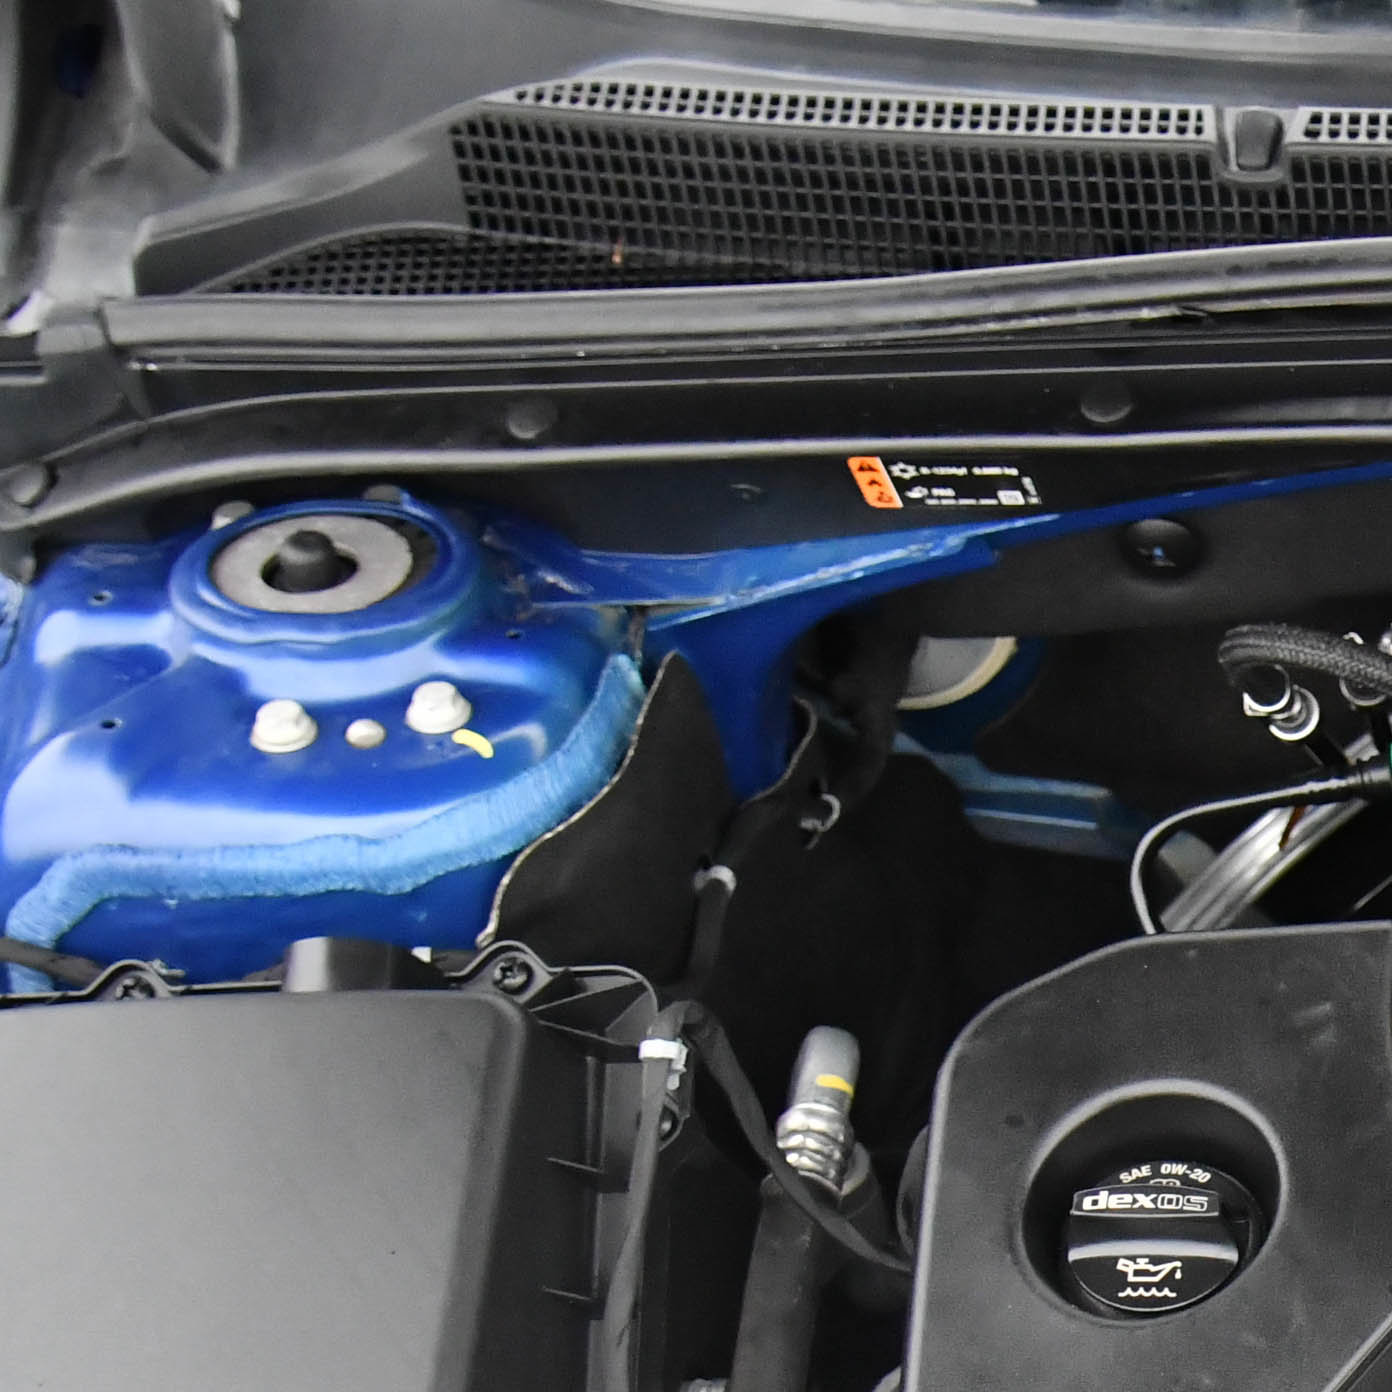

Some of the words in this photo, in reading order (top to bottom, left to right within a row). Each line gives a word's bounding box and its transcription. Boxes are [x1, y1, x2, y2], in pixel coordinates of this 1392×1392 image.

[1119, 1164, 1152, 1184] SAE
[1160, 1163, 1211, 1183] 0W-20
[1082, 1190, 1209, 1212] dexos
